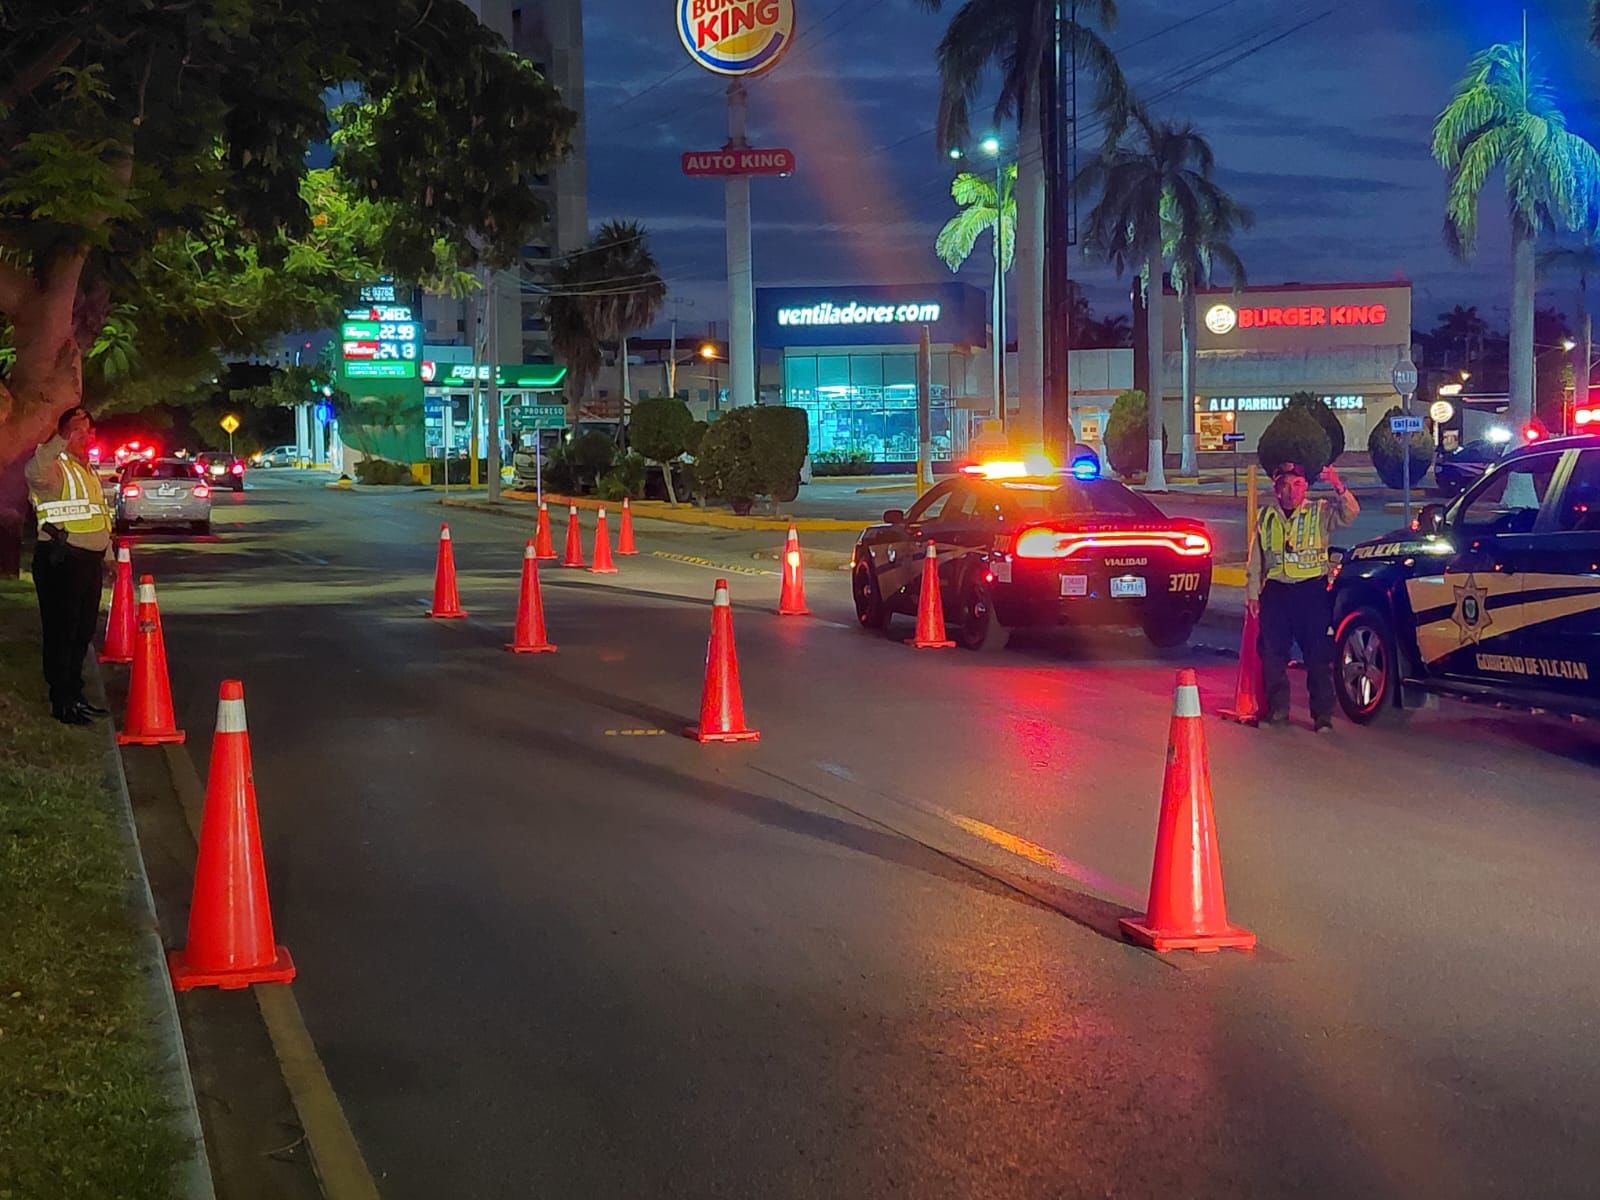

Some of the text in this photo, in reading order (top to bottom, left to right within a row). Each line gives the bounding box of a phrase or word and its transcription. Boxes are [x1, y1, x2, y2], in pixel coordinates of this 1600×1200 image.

[698, 0, 779, 48] KING
[687, 154, 786, 170] AUTO KING
[778, 301, 940, 325] ventiladores.com
[1239, 305, 1325, 328] BURGER
[1330, 304, 1386, 325] KING
[524, 407, 563, 415] PROGRESO
[1209, 398, 1218, 411] A
[1221, 398, 1234, 410] LA
[1334, 395, 1363, 409] 1954
[1350, 543, 1401, 560] POLICIA
[1105, 557, 1148, 567] VIALIDAD
[1168, 573, 1201, 592] 3707
[1523, 656, 1540, 676] DE
[1537, 657, 1589, 680] YUCATAN
